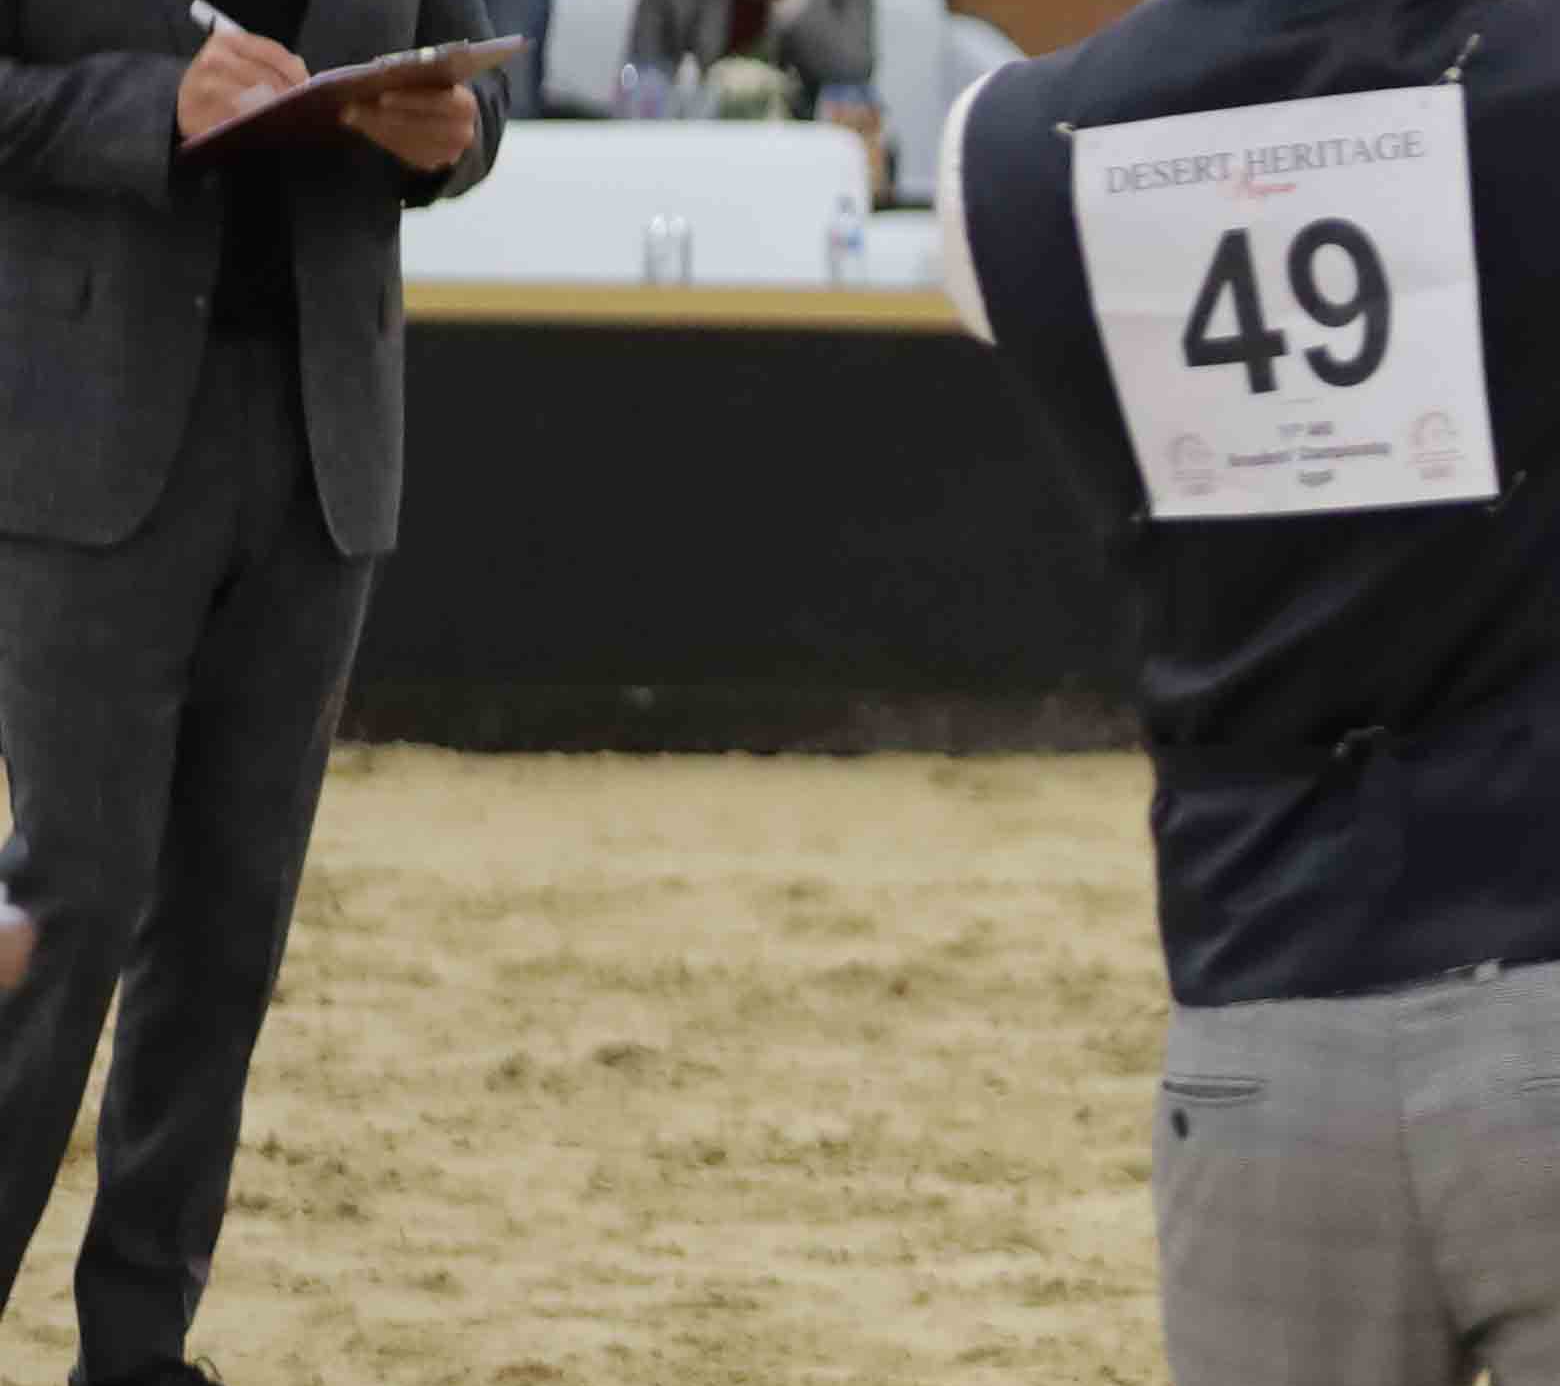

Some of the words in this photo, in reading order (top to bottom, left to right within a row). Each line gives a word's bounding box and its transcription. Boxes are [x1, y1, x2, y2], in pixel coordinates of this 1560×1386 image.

[1105, 150, 1234, 194] DESERT
[1243, 129, 1425, 180] HERITAGE
[1182, 218, 1390, 394] 49
